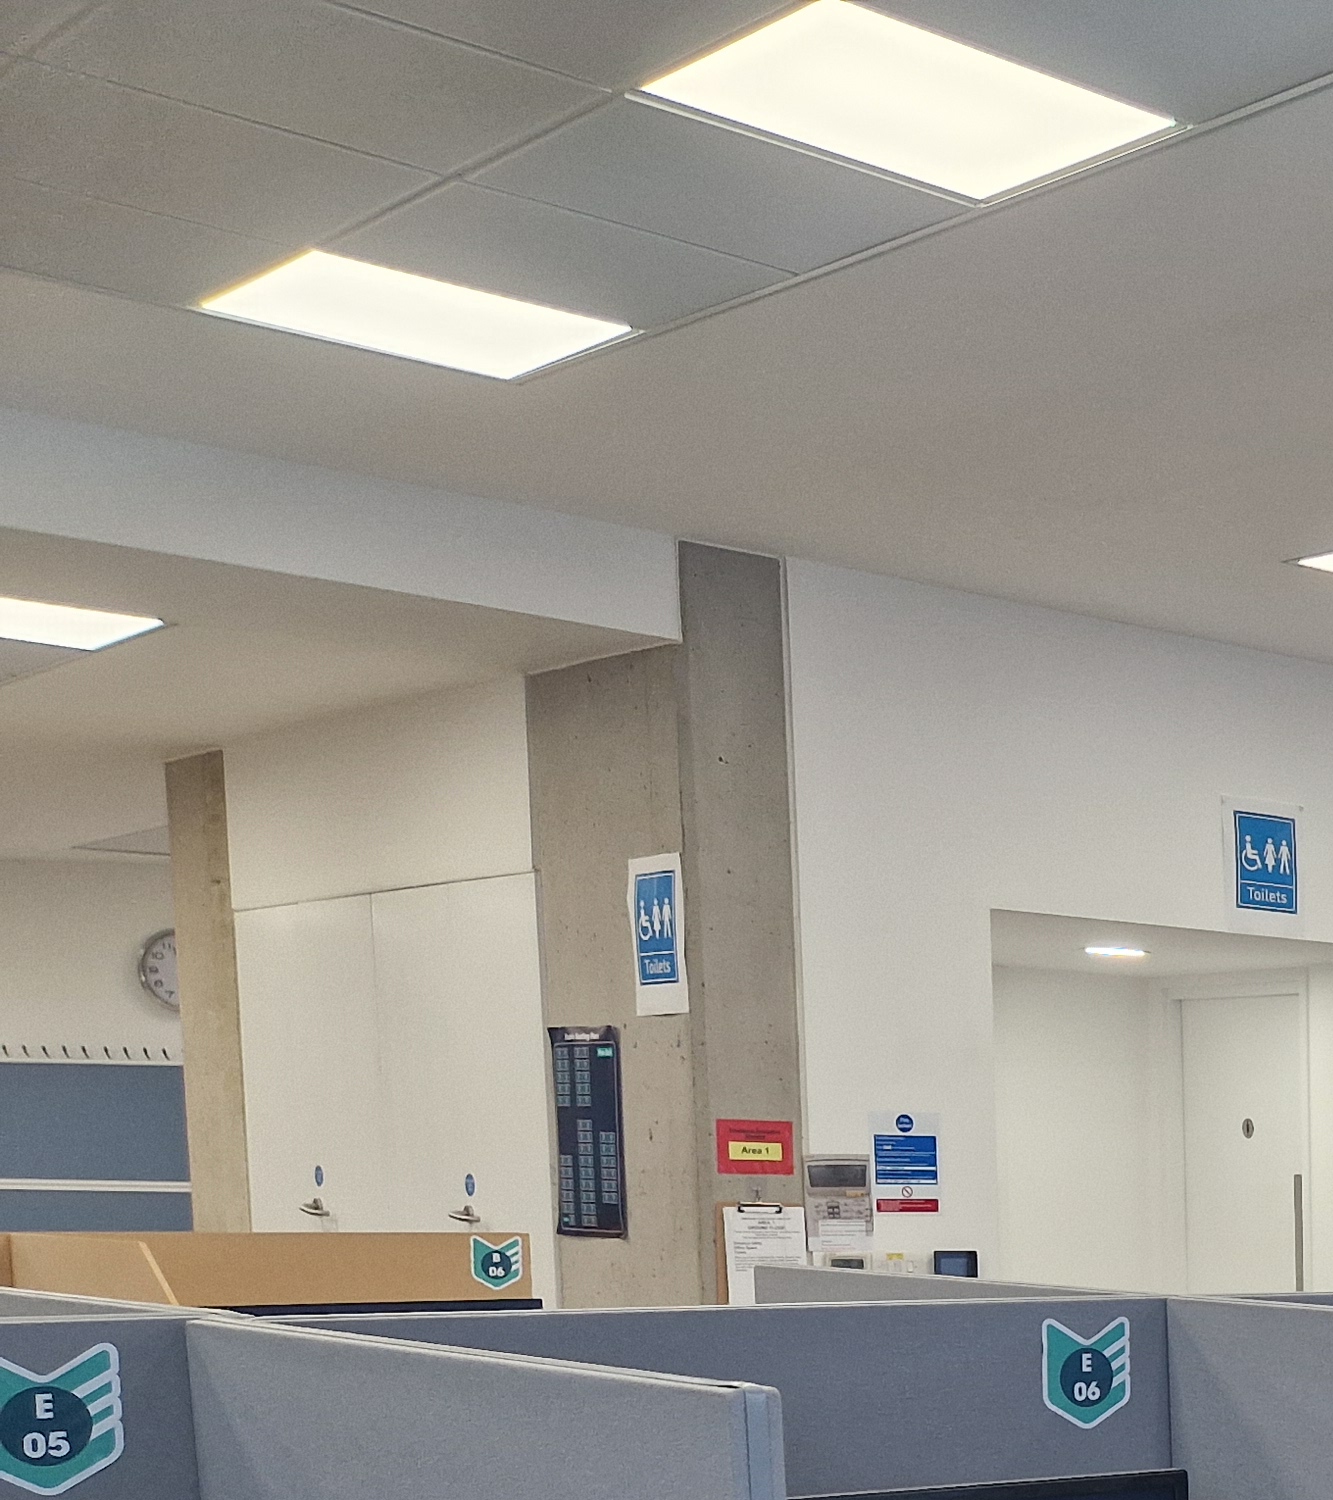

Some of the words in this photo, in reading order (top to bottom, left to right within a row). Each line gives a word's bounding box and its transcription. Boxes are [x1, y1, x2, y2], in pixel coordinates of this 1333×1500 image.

[1246, 886, 1287, 904] Toilets
[644, 959, 671, 975] Toilets
[741, 1146, 763, 1155] Area
[488, 1266, 506, 1277] 06
[1081, 1352, 1093, 1372] E
[1073, 1381, 1101, 1402] 06
[35, 1392, 55, 1419] E
[23, 1430, 71, 1459] 05
